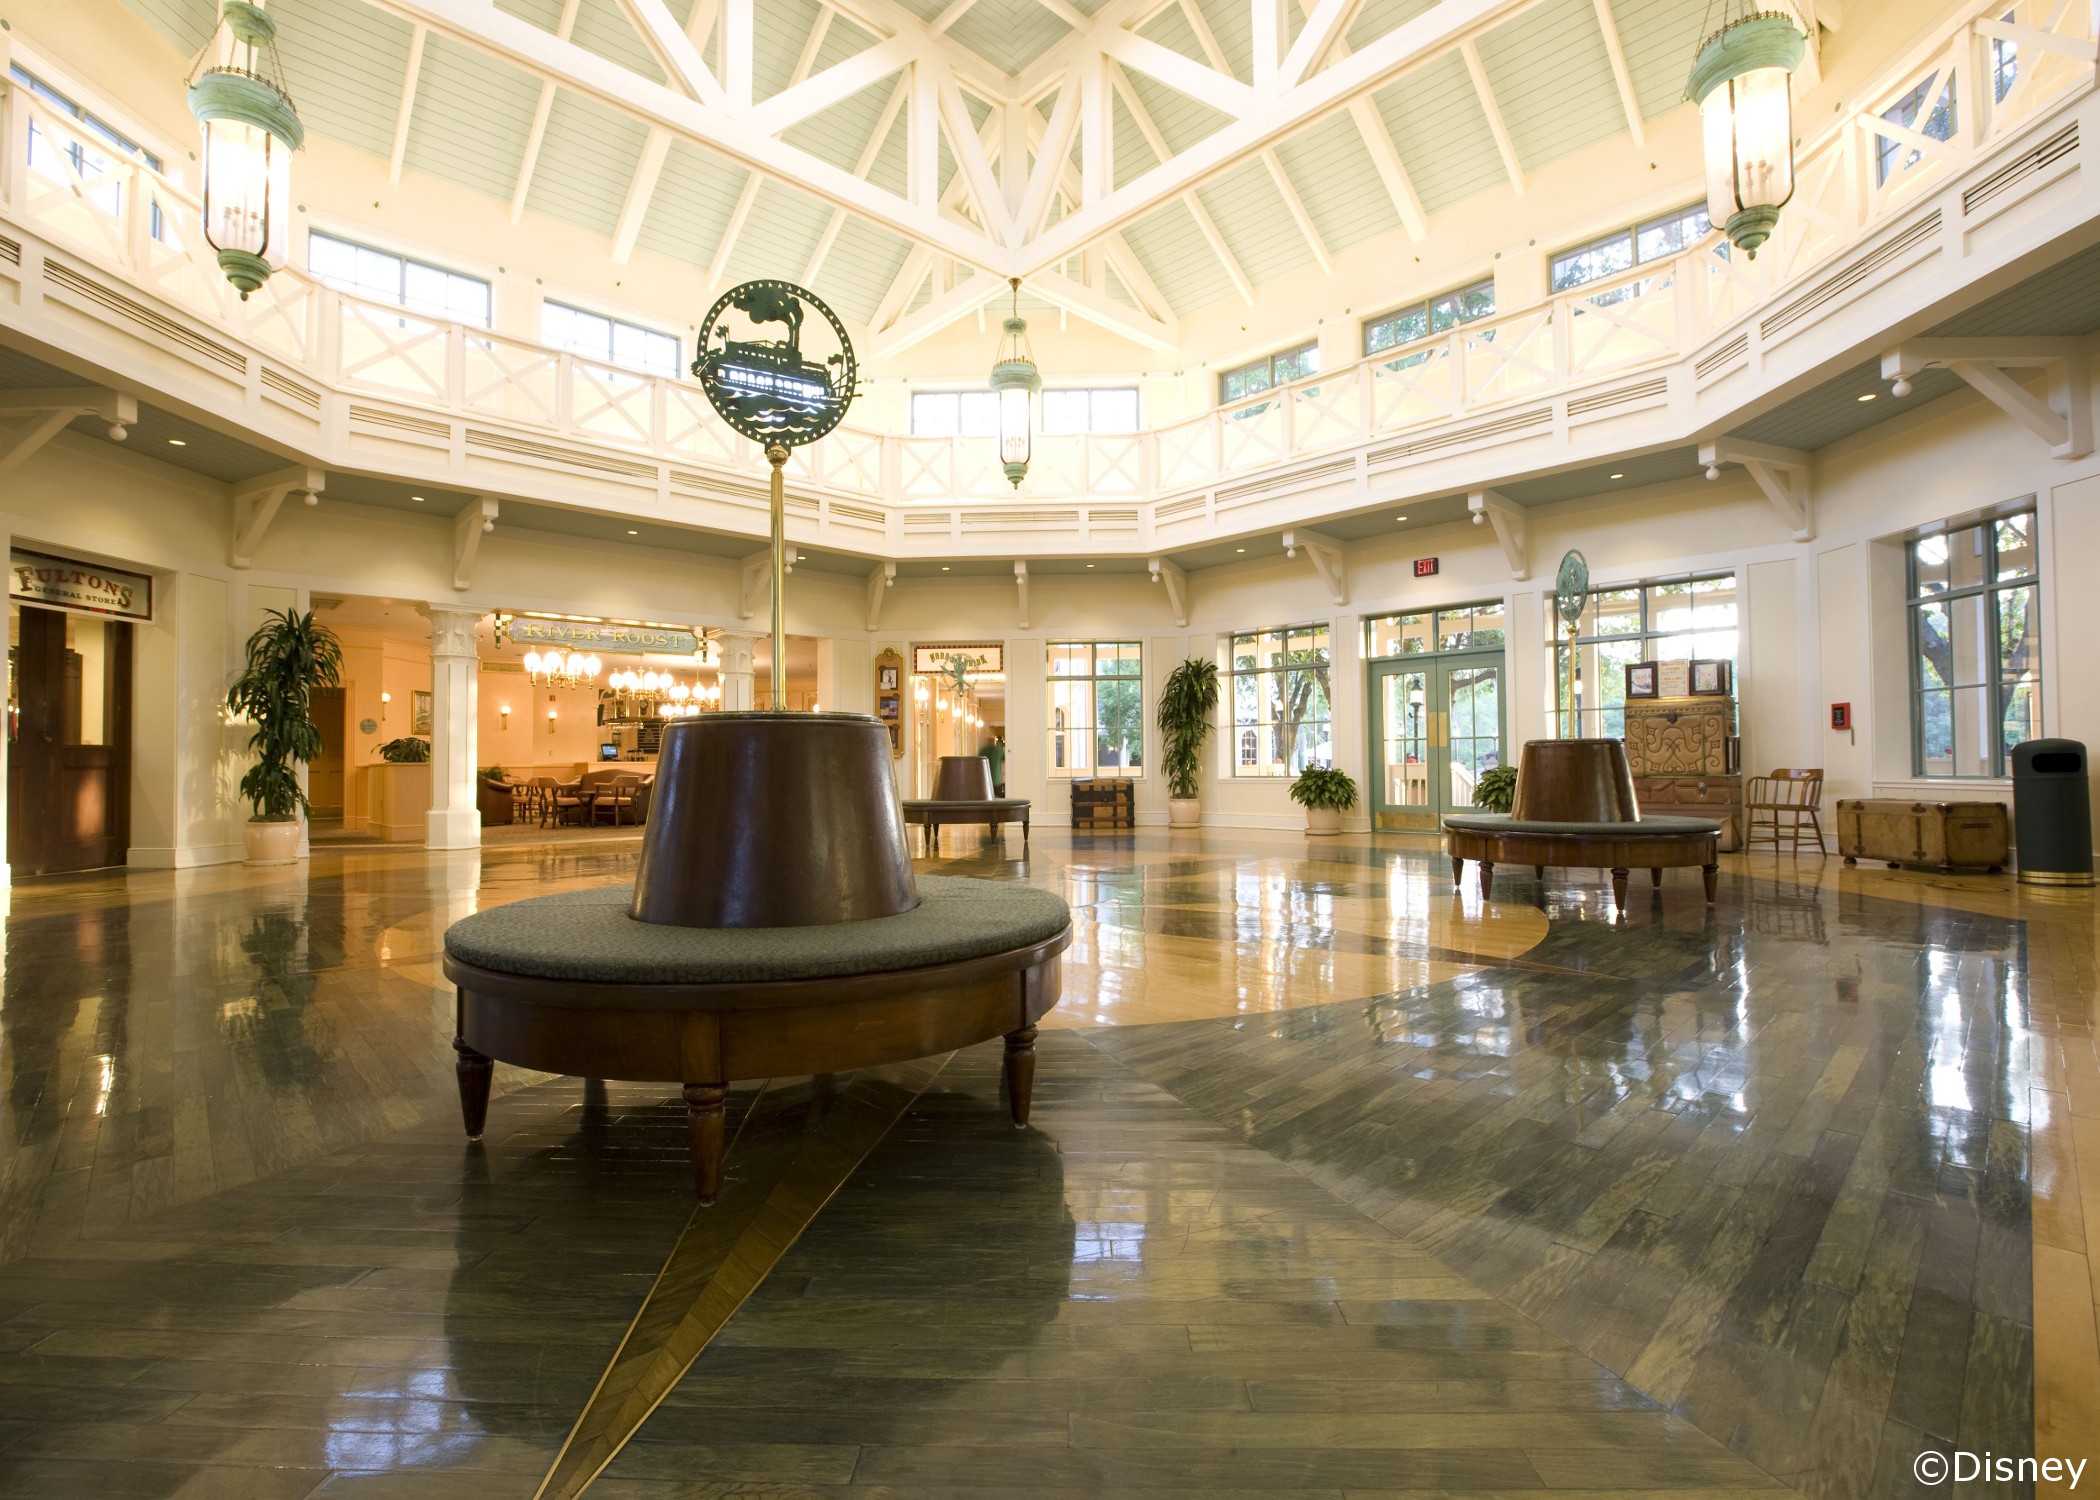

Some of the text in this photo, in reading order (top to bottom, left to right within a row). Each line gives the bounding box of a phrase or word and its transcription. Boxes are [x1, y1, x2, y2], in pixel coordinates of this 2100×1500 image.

[1417, 559, 1434, 574] EXIT
[35, 585, 117, 605] GENERAL STORE
[526, 623, 601, 641] RIVER
[611, 629, 686, 648] ROOST
